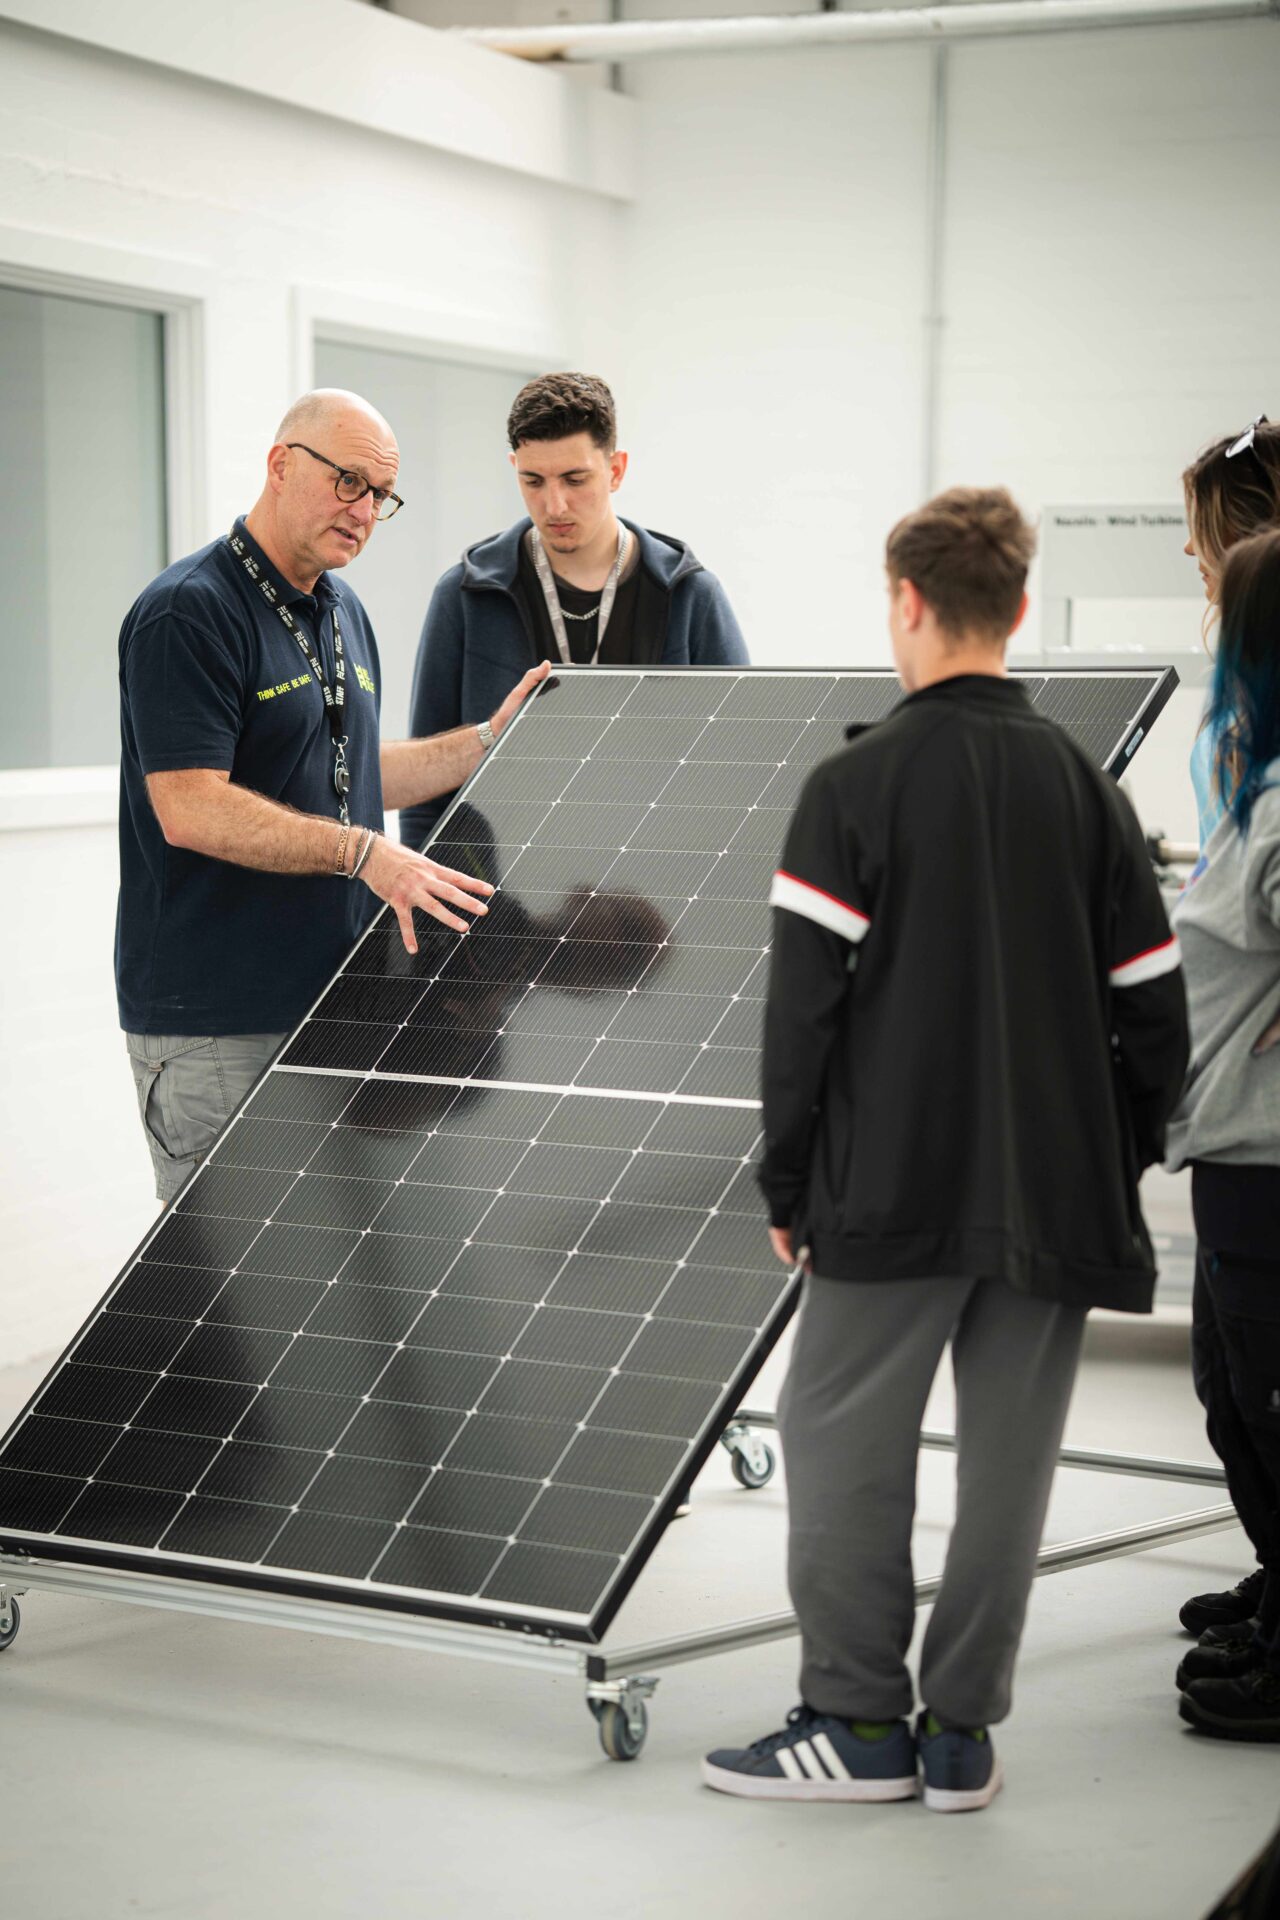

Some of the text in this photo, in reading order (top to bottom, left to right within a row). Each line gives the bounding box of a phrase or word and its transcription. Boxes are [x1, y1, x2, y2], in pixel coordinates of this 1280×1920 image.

[257, 674, 312, 701] THINK SAFE BE SAFE
[323, 686, 335, 706] STAFF
[335, 685, 345, 706] STAFF
